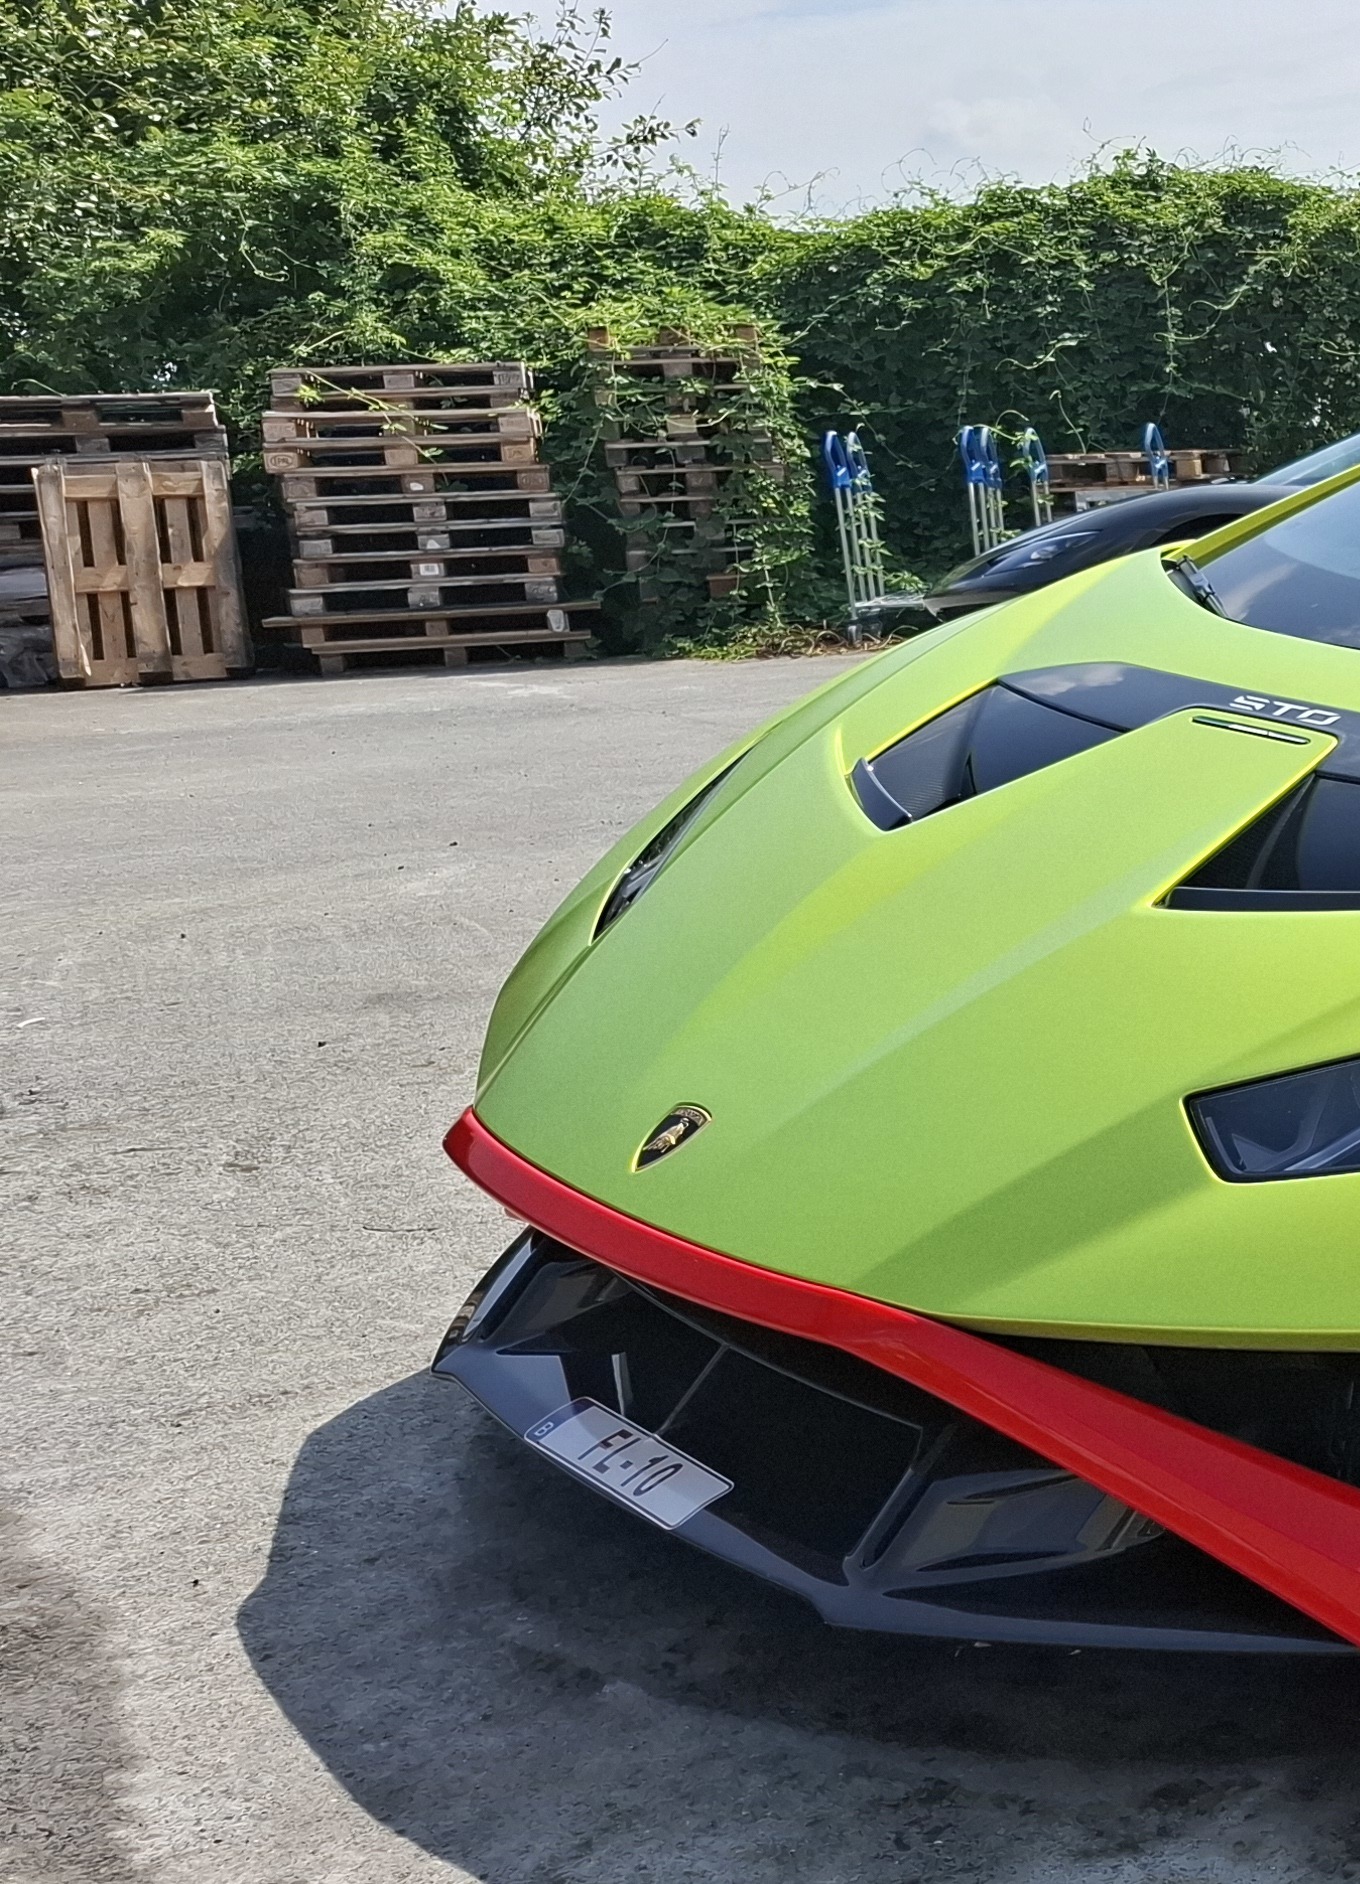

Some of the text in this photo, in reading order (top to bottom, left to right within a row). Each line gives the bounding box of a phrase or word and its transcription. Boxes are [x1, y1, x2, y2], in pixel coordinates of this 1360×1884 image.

[1229, 695, 1341, 726] STO
[534, 1421, 554, 1437] B
[577, 1429, 684, 1497] FL-10
